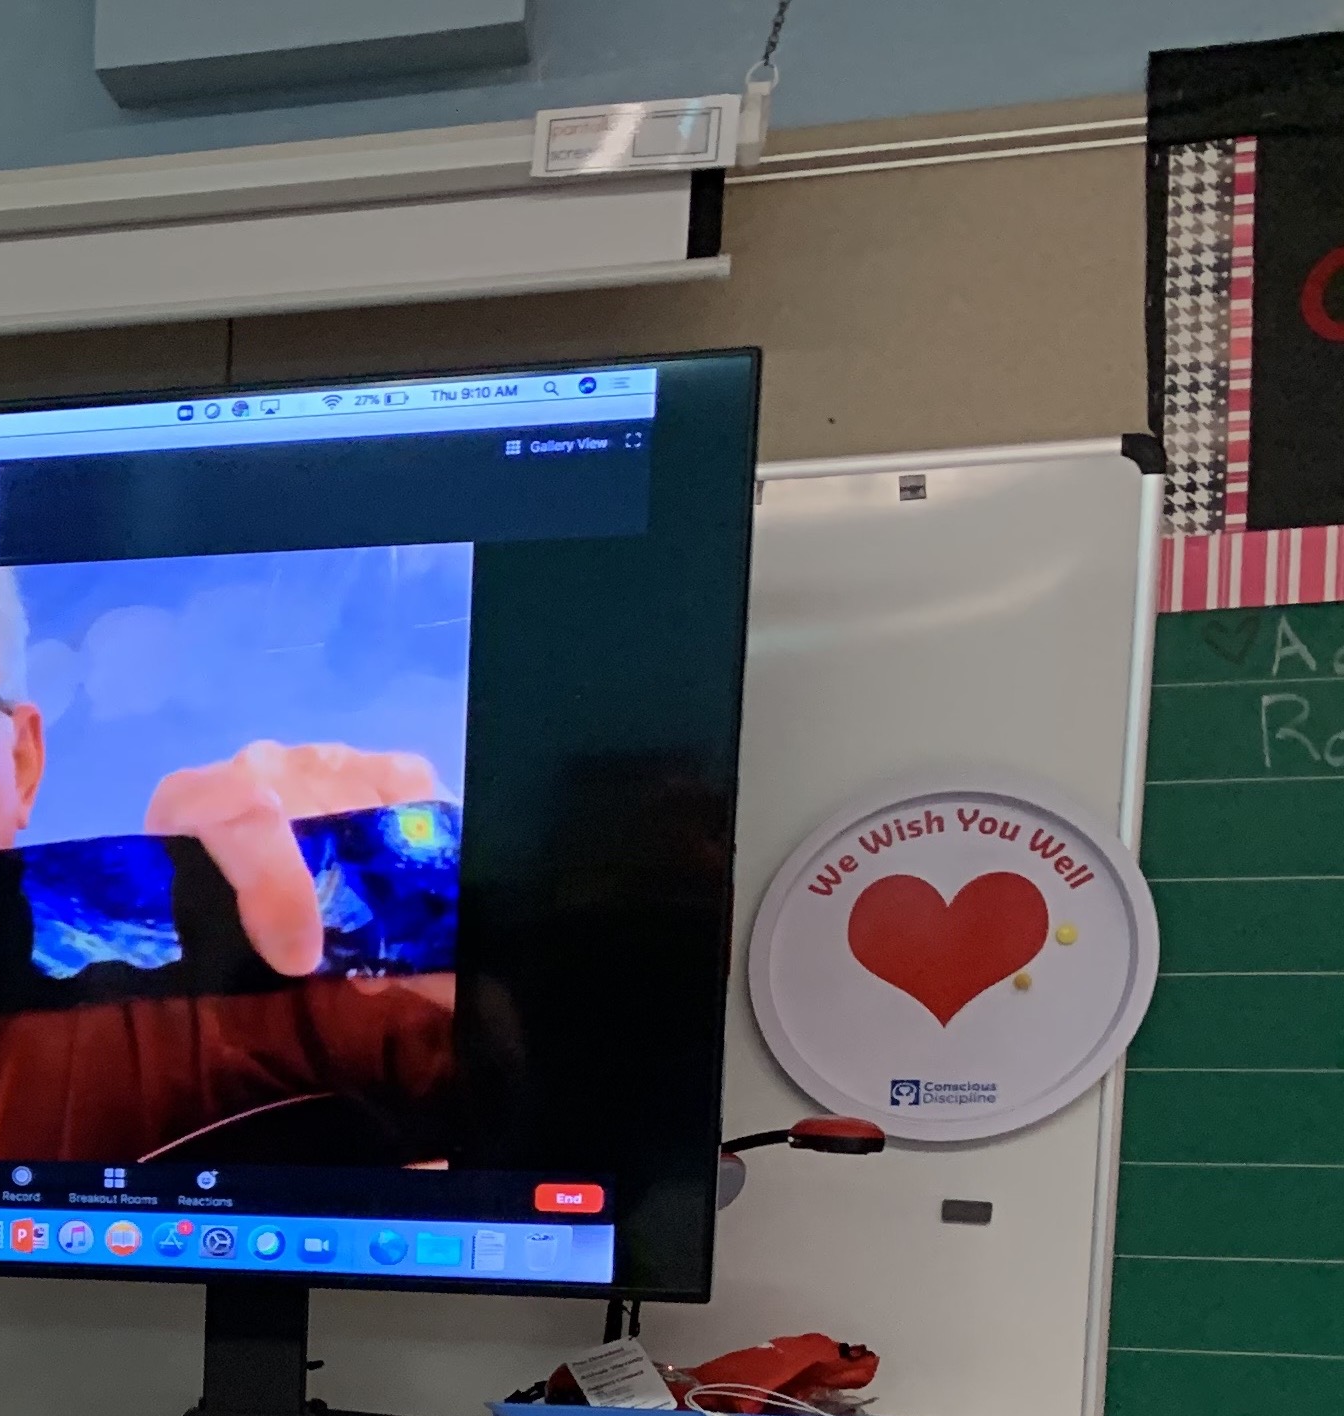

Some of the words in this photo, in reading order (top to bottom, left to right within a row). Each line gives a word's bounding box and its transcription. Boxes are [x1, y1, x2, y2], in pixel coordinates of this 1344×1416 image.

[431, 389, 457, 402] Thu
[461, 387, 491, 400] 9:10
[494, 384, 519, 397] AM
[530, 439, 574, 454] Gallery
[576, 437, 609, 450] View
[808, 854, 859, 896] We
[858, 810, 945, 855] Wish
[957, 808, 1022, 842] You
[1029, 828, 1095, 890] Well
[924, 1081, 997, 1092] Conscious
[923, 1092, 997, 1105] Discipline
[2, 1190, 41, 1202] Record
[68, 1192, 118, 1204] Breakout
[120, 1193, 158, 1205] Rooms
[178, 1195, 234, 1208] Reactions
[555, 1192, 583, 1205] End
[17, 1228, 28, 1243] P
